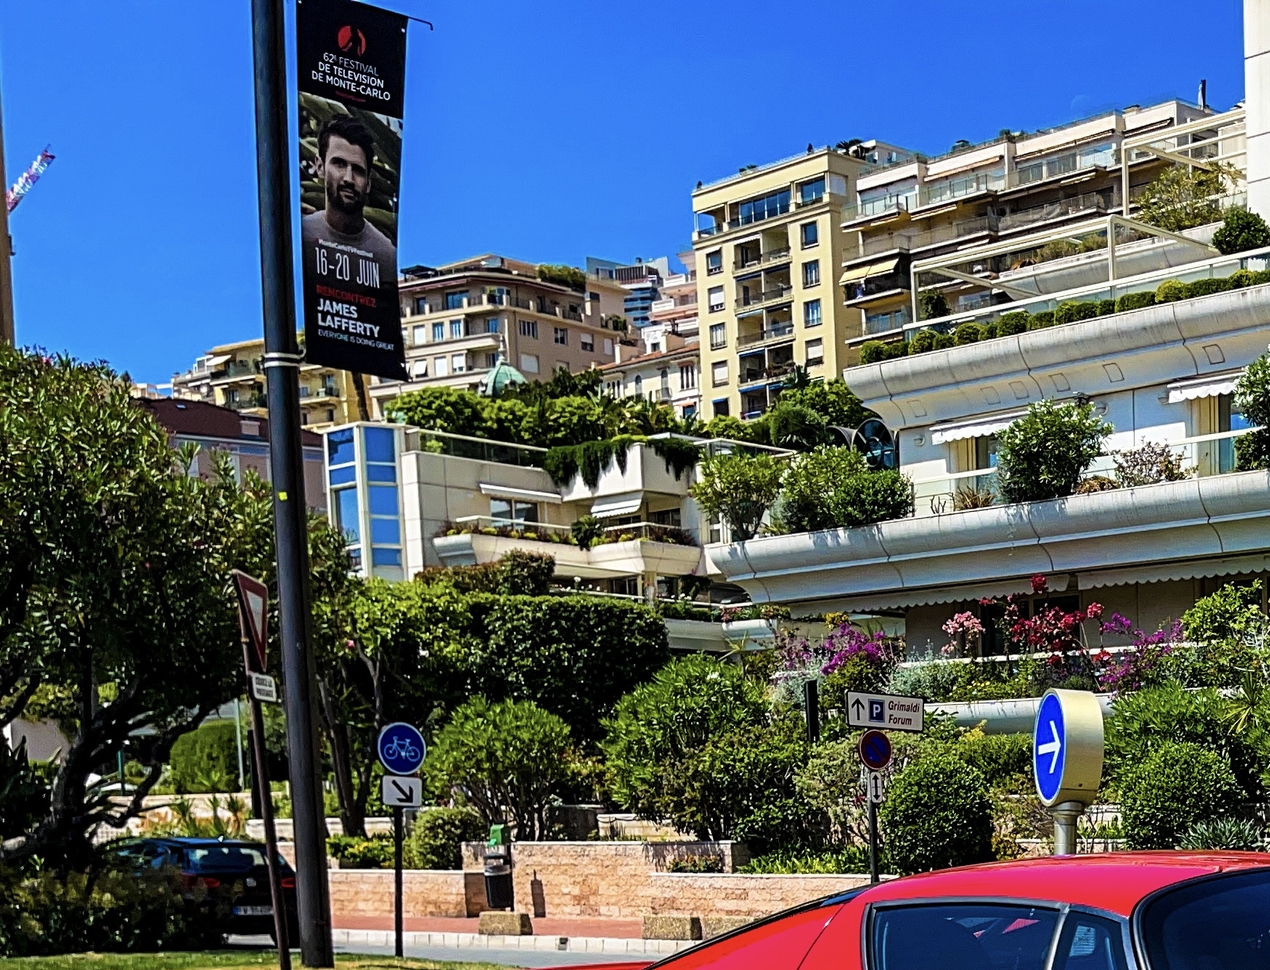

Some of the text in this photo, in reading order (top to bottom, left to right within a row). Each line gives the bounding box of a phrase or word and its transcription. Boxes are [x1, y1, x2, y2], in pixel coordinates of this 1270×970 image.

[318, 61, 384, 88] DE TELEVISION
[339, 56, 379, 76] FESTIVAL
[311, 70, 324, 82] DE
[326, 75, 391, 100] MONTE-CARLO
[315, 247, 350, 281] 16-20
[357, 259, 380, 289] JUIN
[317, 298, 358, 318] JAMES
[317, 313, 380, 338] LAFFERTY
[318, 329, 349, 342] EVERYONE
[356, 337, 376, 348] DOING
[376, 341, 395, 351] GREAT
[872, 700, 920, 718] P Grimaldi
[888, 714, 912, 726] Forum
